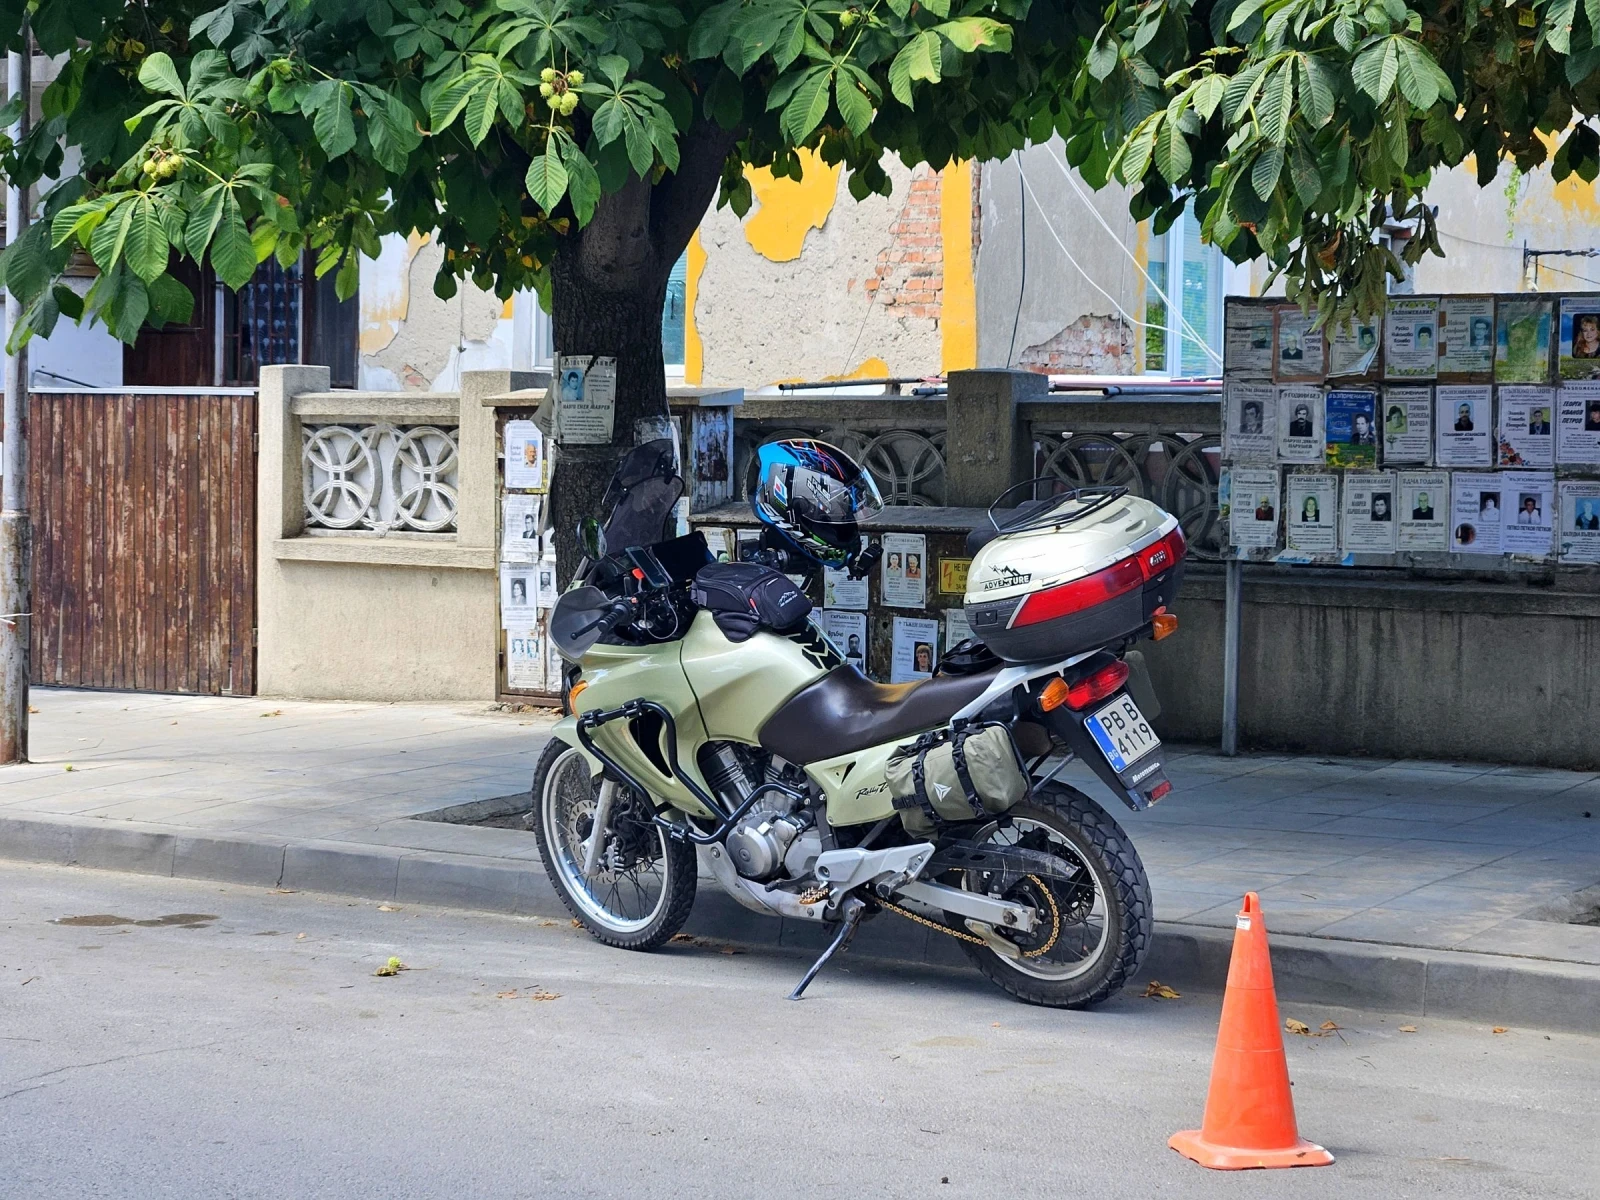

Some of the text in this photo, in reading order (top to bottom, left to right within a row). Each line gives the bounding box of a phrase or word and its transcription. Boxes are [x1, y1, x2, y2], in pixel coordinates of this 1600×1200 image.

[984, 575, 1030, 590] ADVENTURE
[1100, 703, 1139, 736] PB B
[1117, 722, 1153, 756] 4119
[1108, 749, 1119, 761] BG
